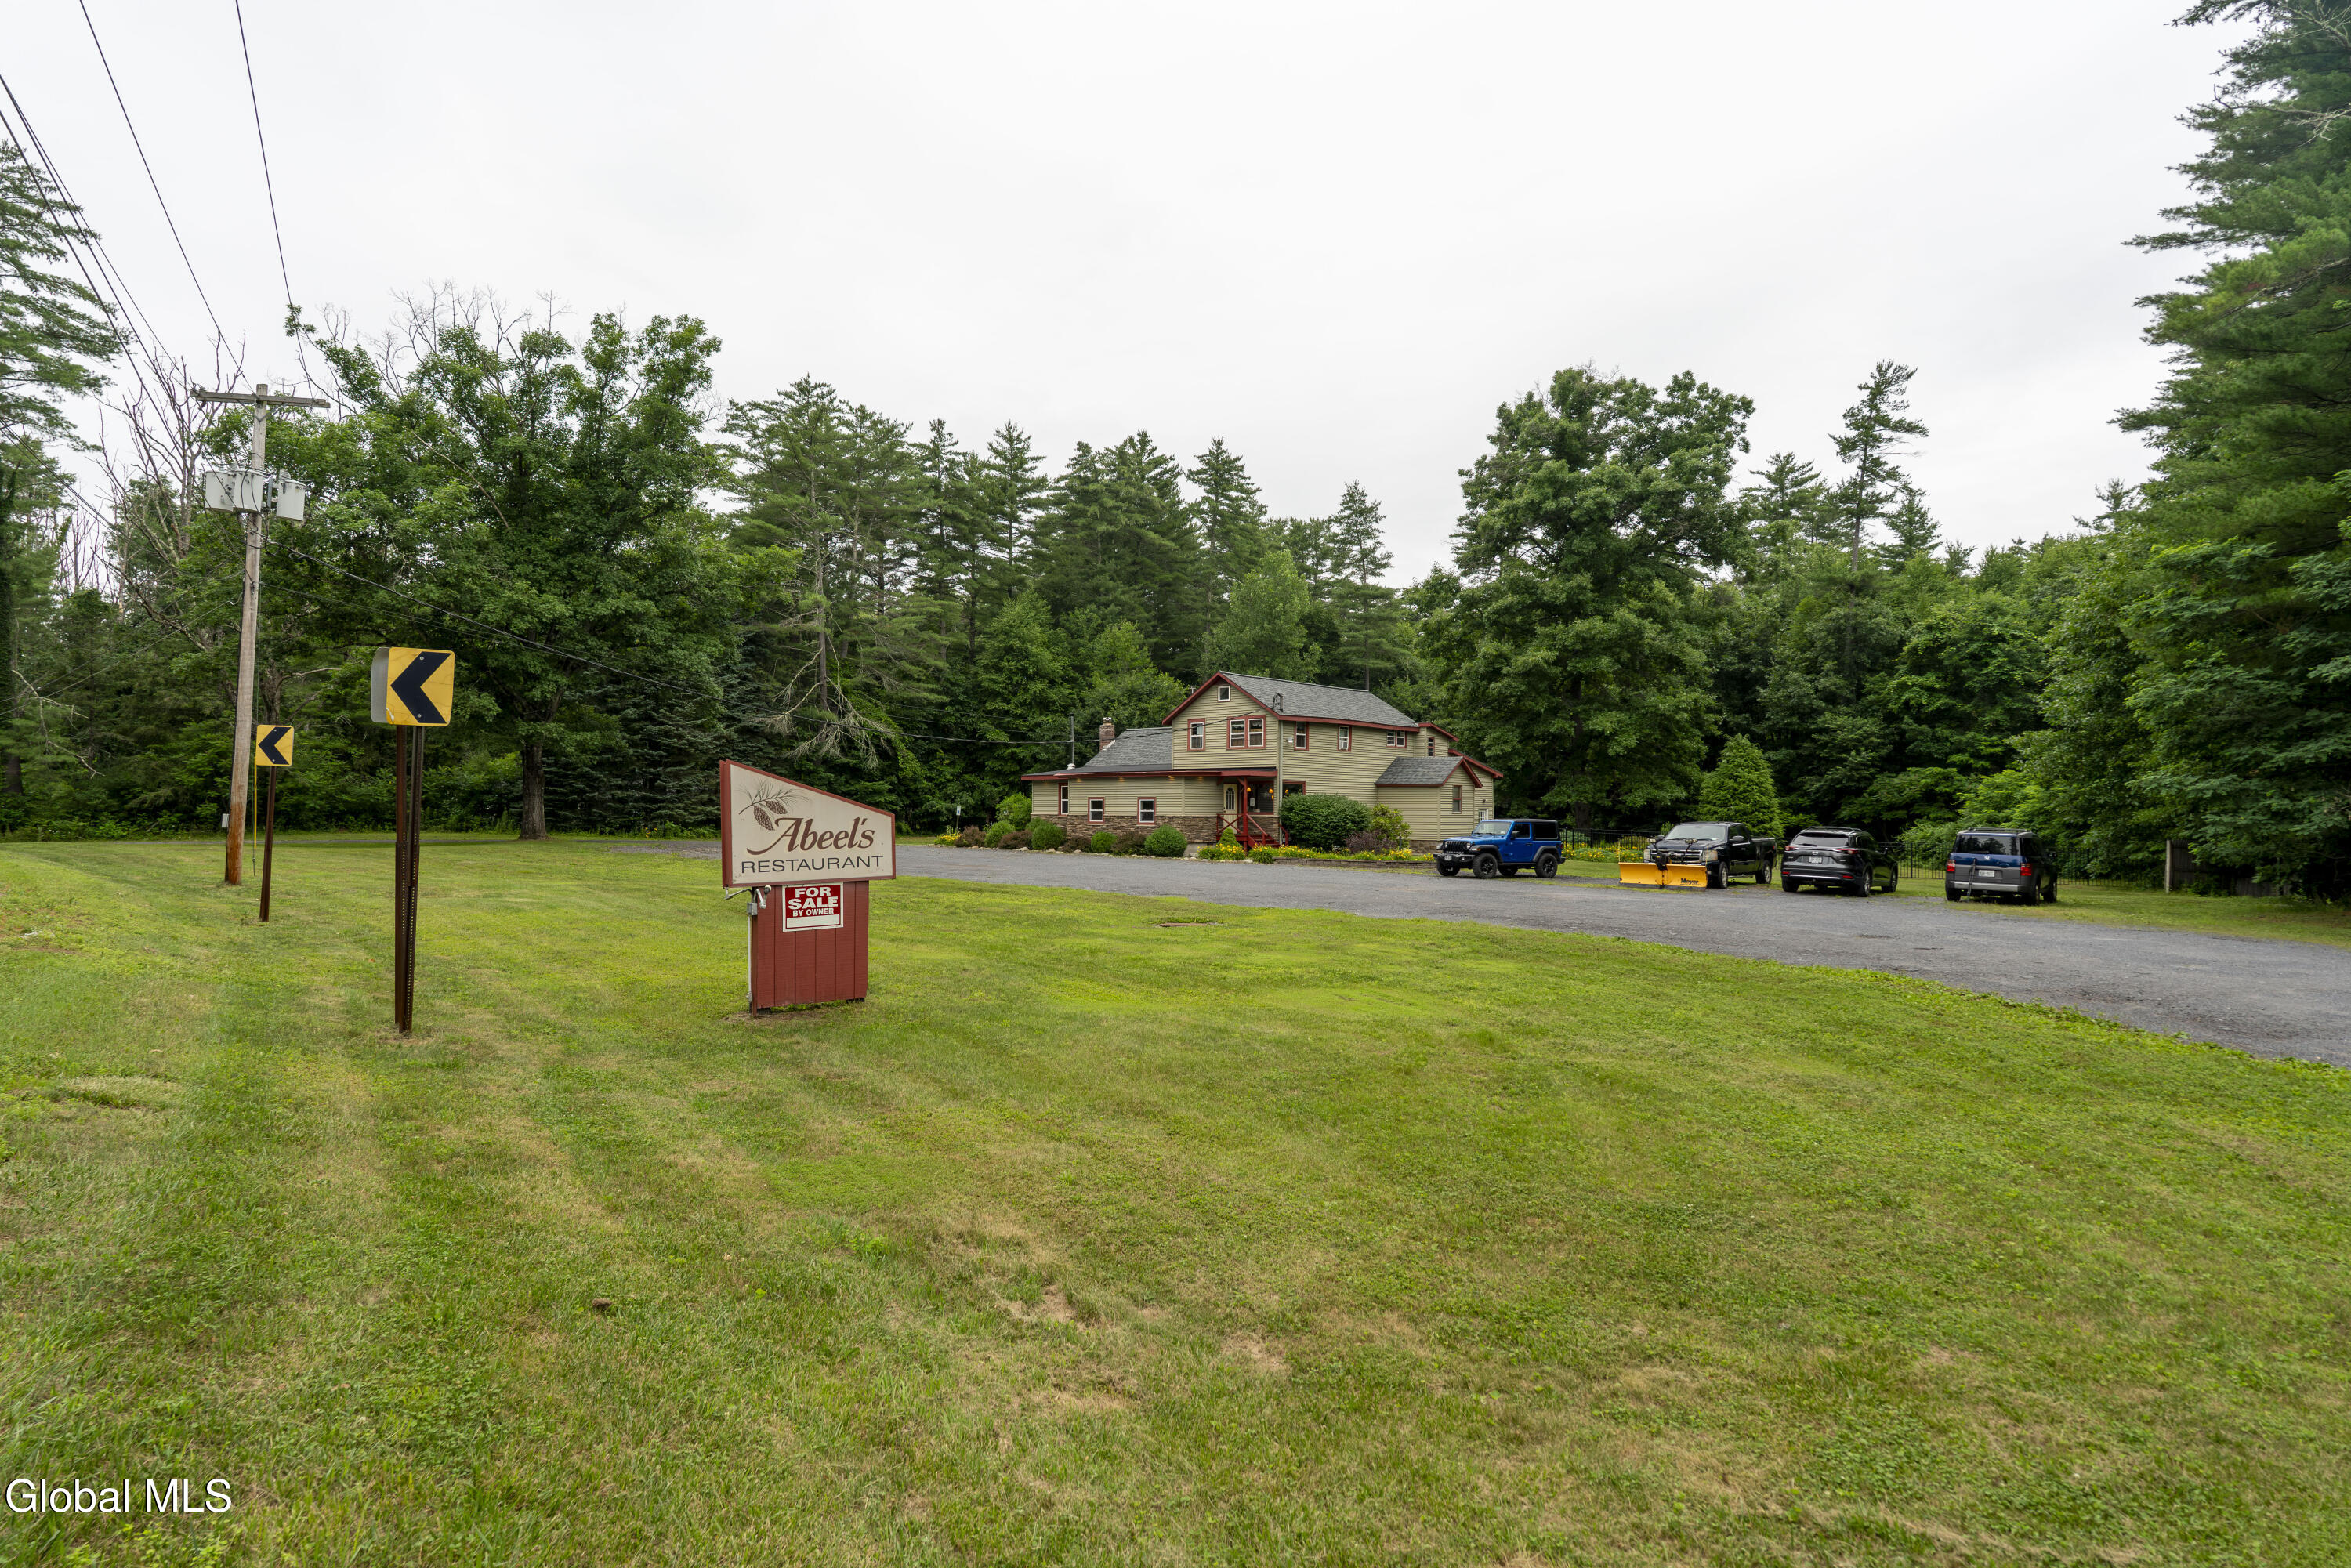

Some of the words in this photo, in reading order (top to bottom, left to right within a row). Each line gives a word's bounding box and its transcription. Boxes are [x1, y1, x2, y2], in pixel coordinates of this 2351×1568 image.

[746, 817, 875, 856] Abeel's
[741, 855, 884, 874] RESTAURANT
[795, 886, 831, 898] FOR
[788, 896, 839, 910] SALE
[806, 907, 835, 916] OWNER
